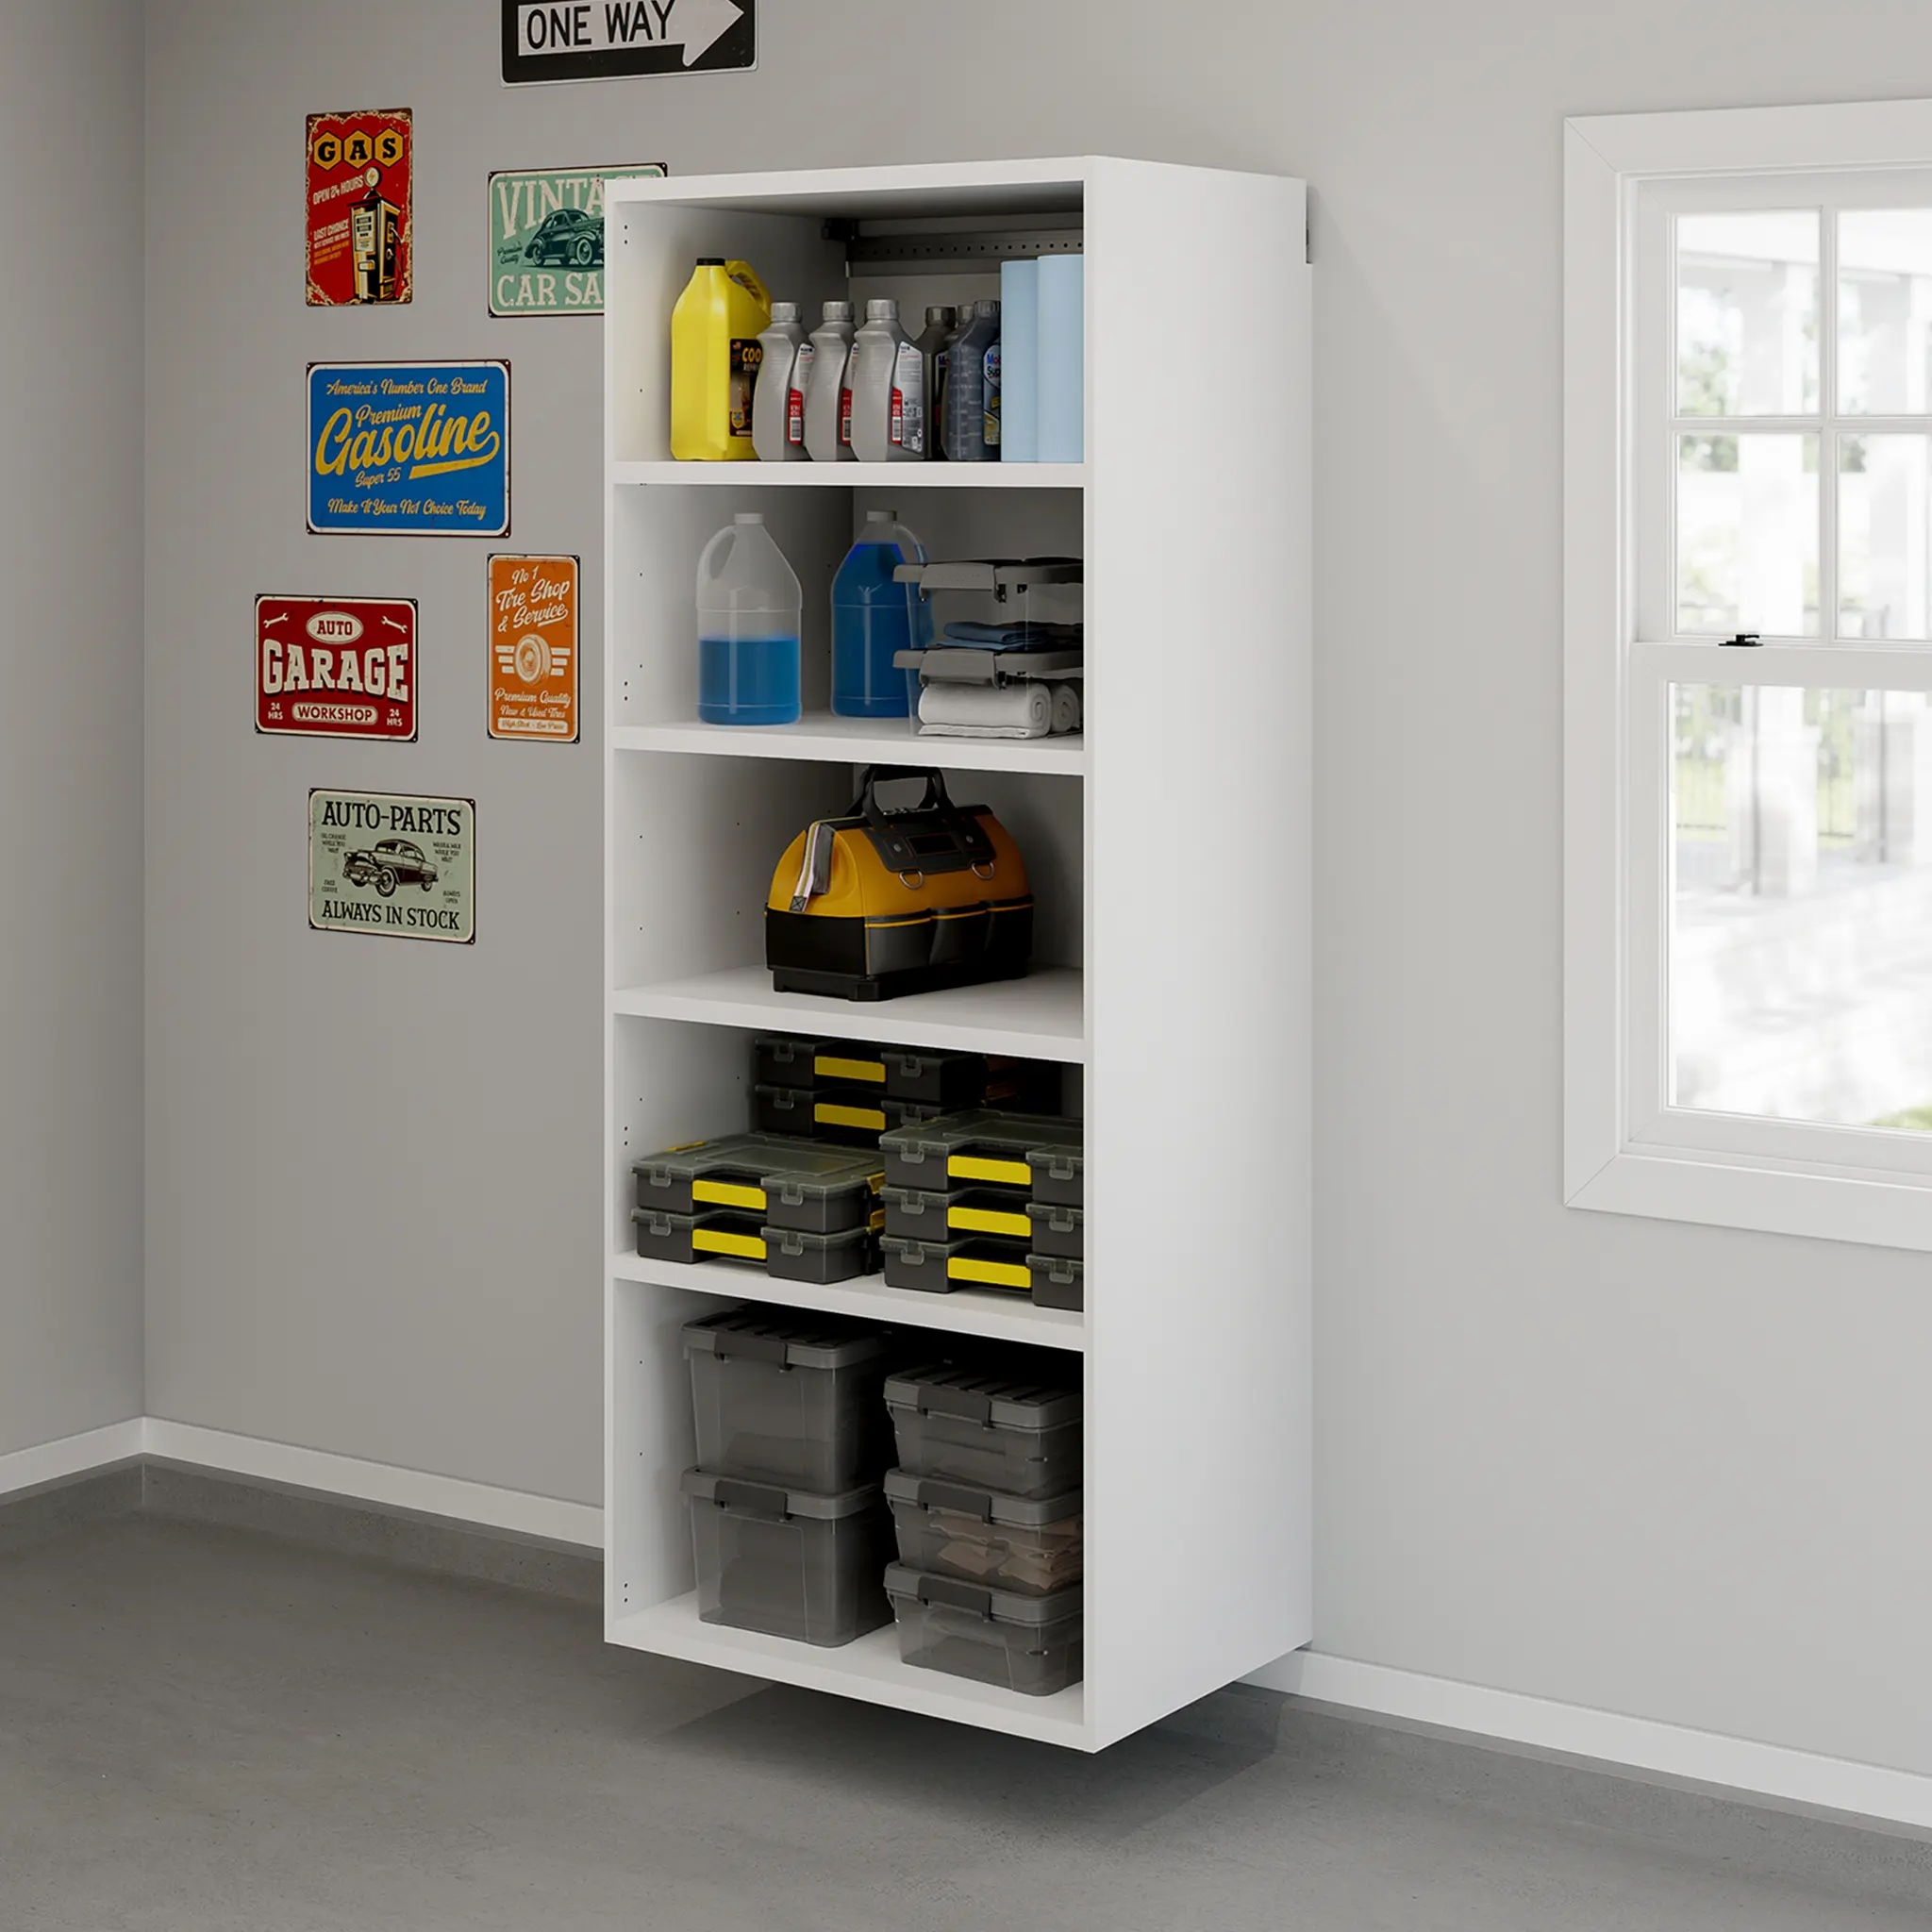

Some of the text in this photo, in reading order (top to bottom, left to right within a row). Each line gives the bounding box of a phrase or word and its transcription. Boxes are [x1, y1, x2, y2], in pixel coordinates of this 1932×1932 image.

[526, 0, 675, 49] ONE WAY
[317, 137, 396, 162] GAS
[313, 175, 364, 205] OPEN 24 HOURS
[497, 175, 605, 240] VINTA
[497, 272, 605, 307] CAR SA
[742, 347, 761, 363] COO
[326, 377, 488, 395] America's Number One Brand
[355, 404, 422, 427] Premium
[315, 403, 499, 479] Gasoline
[355, 467, 401, 489] Super 55
[327, 498, 358, 514] Make
[360, 498, 373, 513] It
[373, 498, 397, 516] Your
[423, 498, 454, 515] Choice
[456, 500, 487, 521] Today
[511, 565, 539, 585] No 1
[495, 578, 571, 611] Tire Shop
[316, 620, 354, 636] AUTO
[497, 603, 568, 632] & Service
[263, 639, 408, 703] GARAGE
[271, 702, 281, 710] 24
[494, 688, 571, 708] Premium Quality
[268, 711, 283, 720] HRS
[298, 706, 373, 722] WORKSHOP
[387, 718, 403, 726] HRS
[390, 708, 400, 717] 24
[322, 801, 461, 836] AUTO-PARTS
[322, 900, 460, 930] ALWAYS IN STOCK
